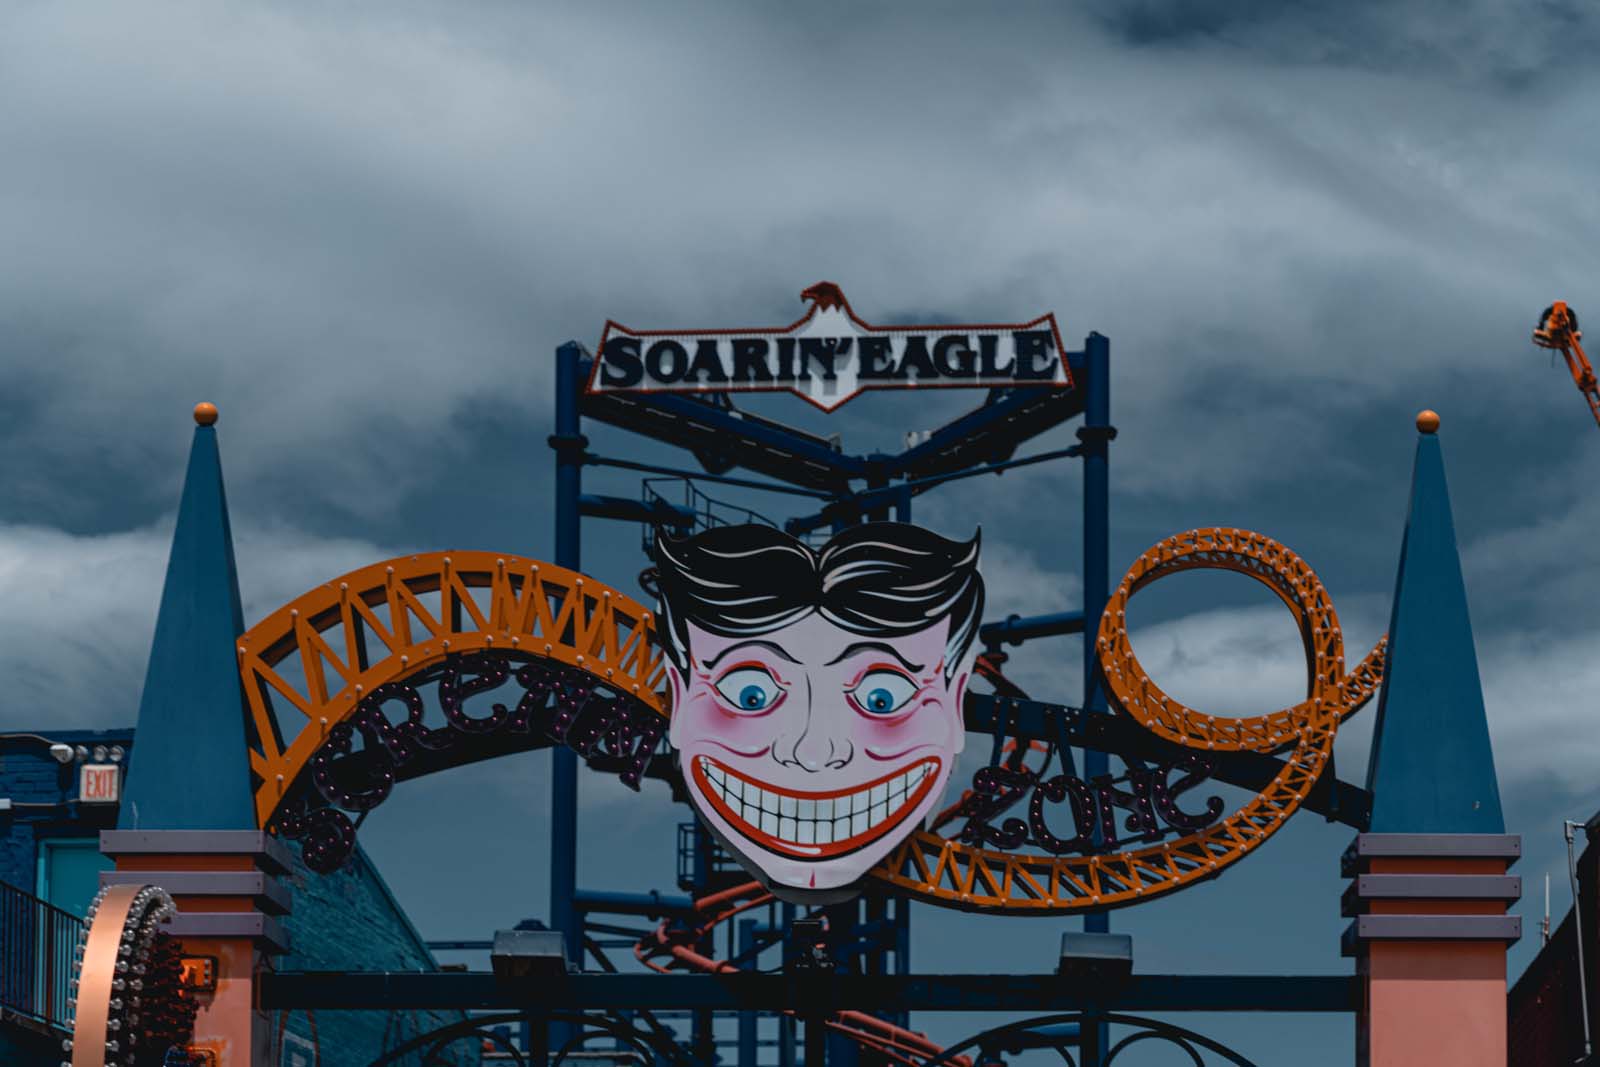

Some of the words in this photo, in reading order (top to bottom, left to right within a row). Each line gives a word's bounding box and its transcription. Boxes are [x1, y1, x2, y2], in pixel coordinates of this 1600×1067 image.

[600, 337, 855, 387] SOARIN'
[857, 330, 1059, 380] EAGLE
[86, 770, 114, 797] EXIT
